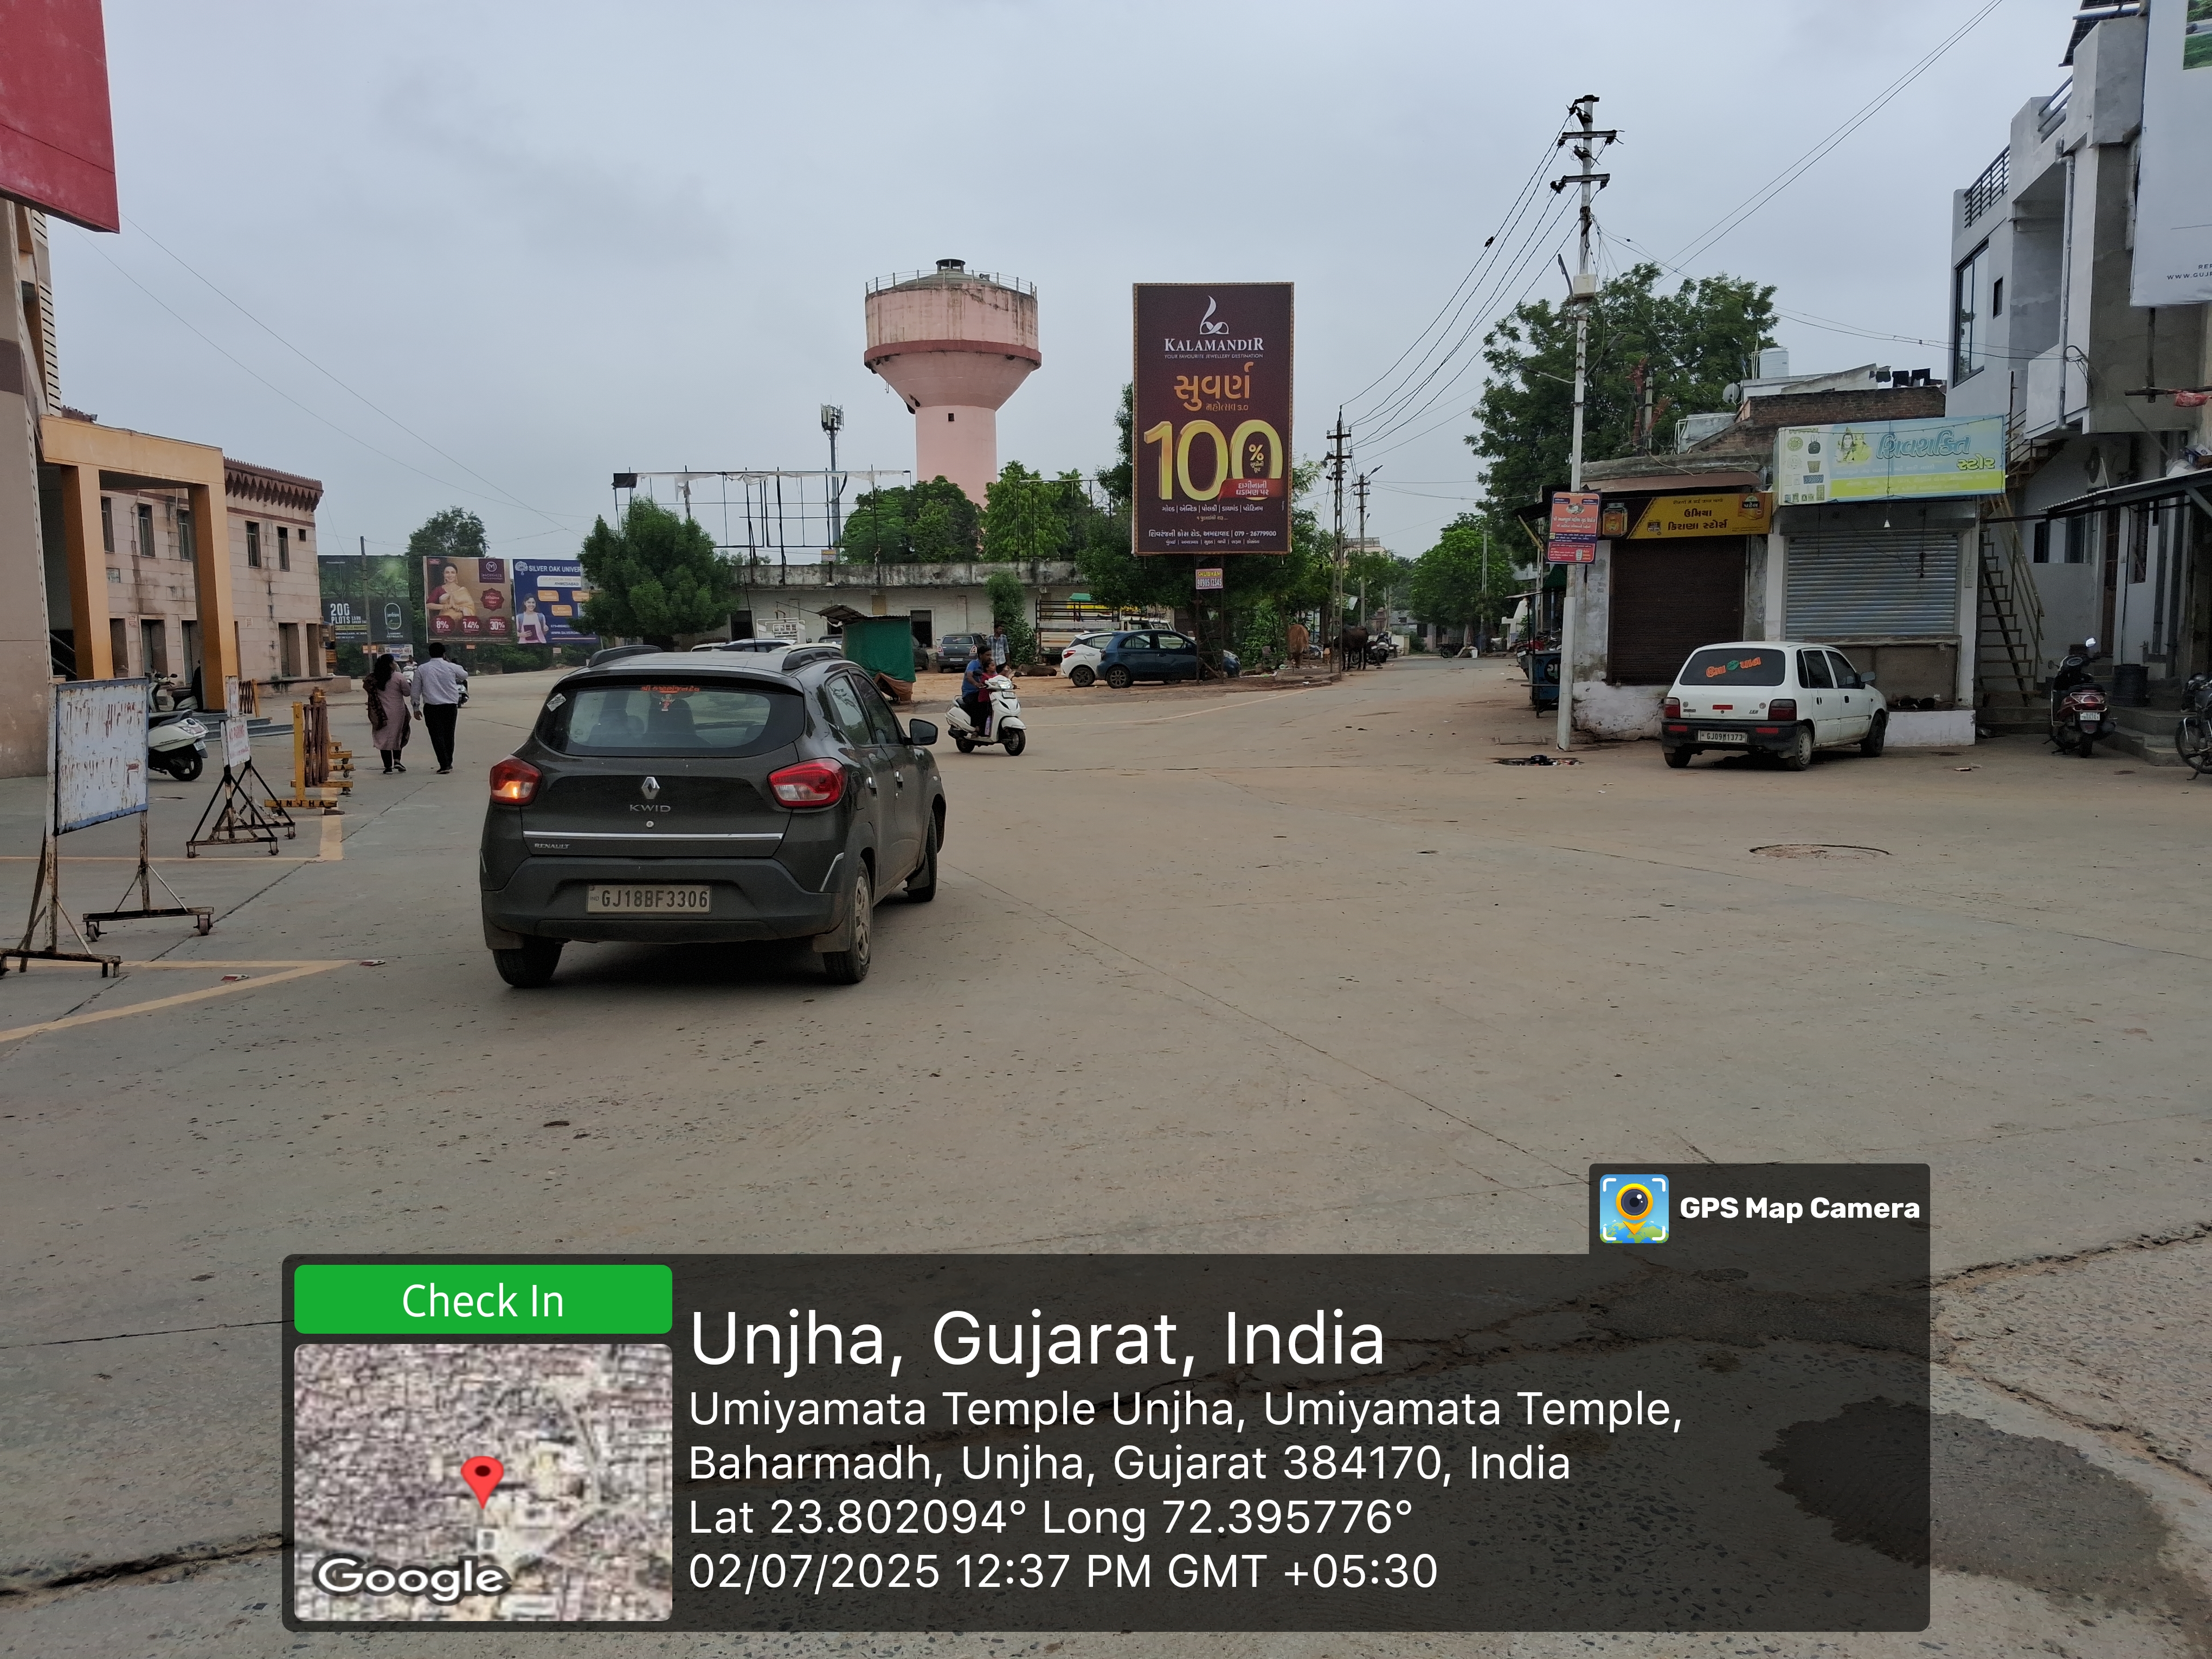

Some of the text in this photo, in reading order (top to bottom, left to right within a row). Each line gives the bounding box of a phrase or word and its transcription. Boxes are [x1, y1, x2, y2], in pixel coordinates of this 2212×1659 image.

[1165, 338, 1264, 351] KALAMANDIR
[1174, 362, 1254, 411] સુવર્ણ
[1206, 401, 1236, 411] મહોત્સવ
[1876, 428, 1971, 460] શિવશક્તિ
[1249, 444, 1264, 461] %
[1144, 419, 1283, 501] 100
[1957, 453, 1996, 471] સ્ટોર
[1238, 480, 1267, 490] દાગીનાની
[1201, 504, 1217, 512] પોલકી
[1243, 504, 1263, 512] પ્લેટિનમ
[1684, 508, 1712, 517] ઉમિયા
[1668, 521, 1699, 531] કિરાણા
[1702, 519, 1728, 529] સ્ટોર્સ
[1149, 529, 1175, 537] શિવરંજની
[1190, 529, 1202, 537] રોડ,
[1197, 578, 1222, 587] 98985 12345
[330, 603, 350, 616] 200
[331, 616, 350, 625] PLOTS
[436, 620, 449, 629] 8%
[462, 621, 479, 629] 14%
[490, 621, 505, 630] 30%
[1707, 732, 1743, 741] GJ09M1373
[602, 890, 708, 908] GJ18BF3306
